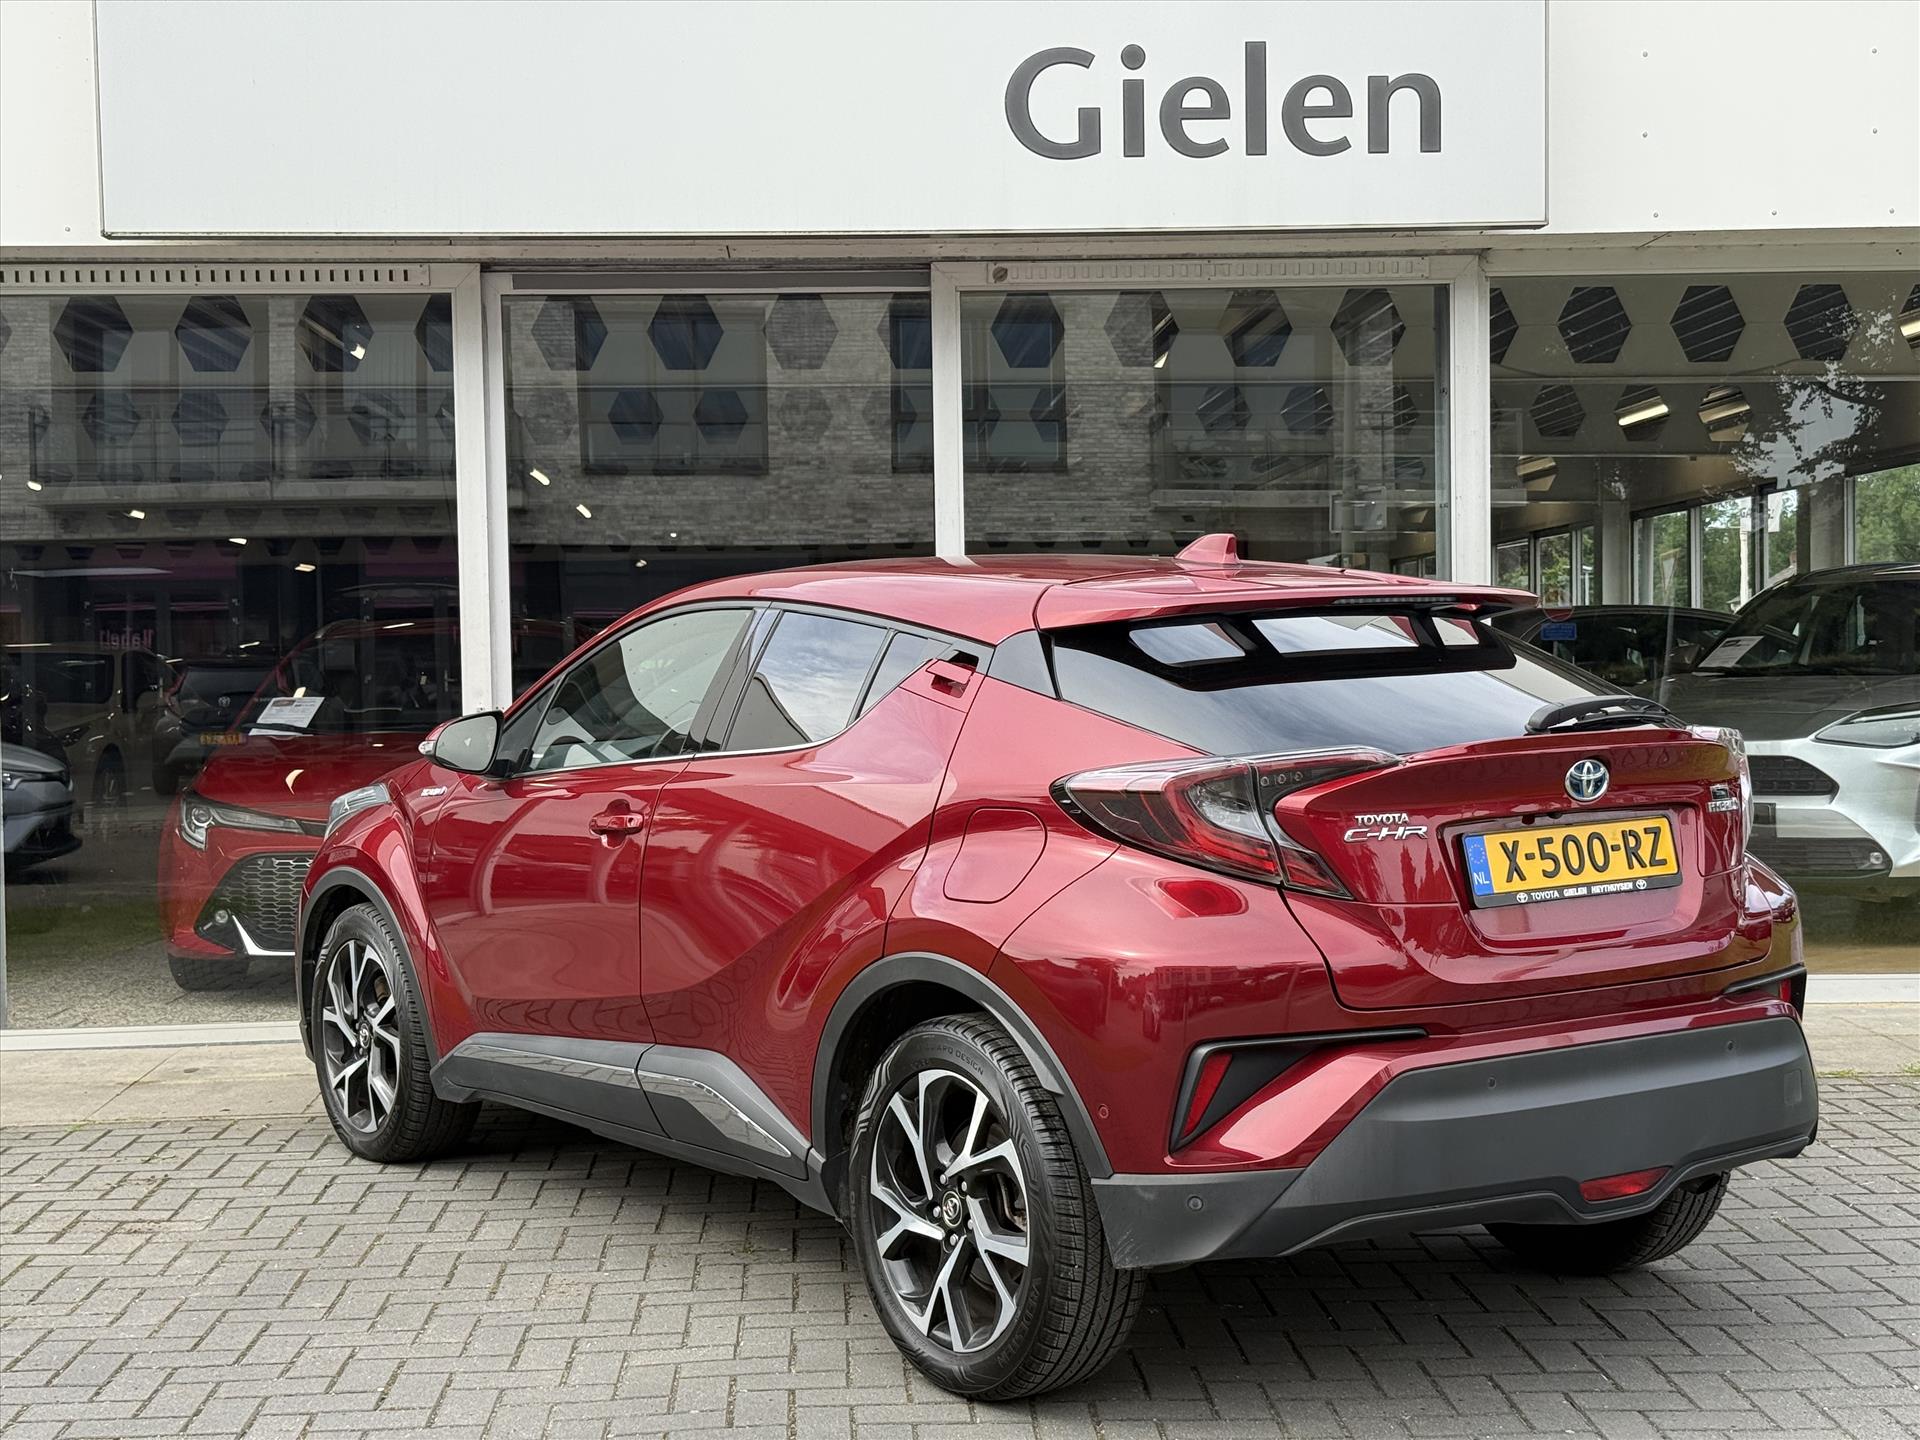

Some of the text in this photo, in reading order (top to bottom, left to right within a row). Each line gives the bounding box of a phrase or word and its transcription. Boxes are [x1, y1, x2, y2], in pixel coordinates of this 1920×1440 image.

[1004, 41, 1442, 160] Gielen
[1354, 812, 1409, 827] TOYOTA
[1343, 825, 1428, 843] C-HR
[1499, 826, 1668, 883] X-500-RZ
[1473, 872, 1490, 885] NL
[1530, 891, 1560, 901] TOYOTA
[1563, 886, 1588, 897] GIELEN
